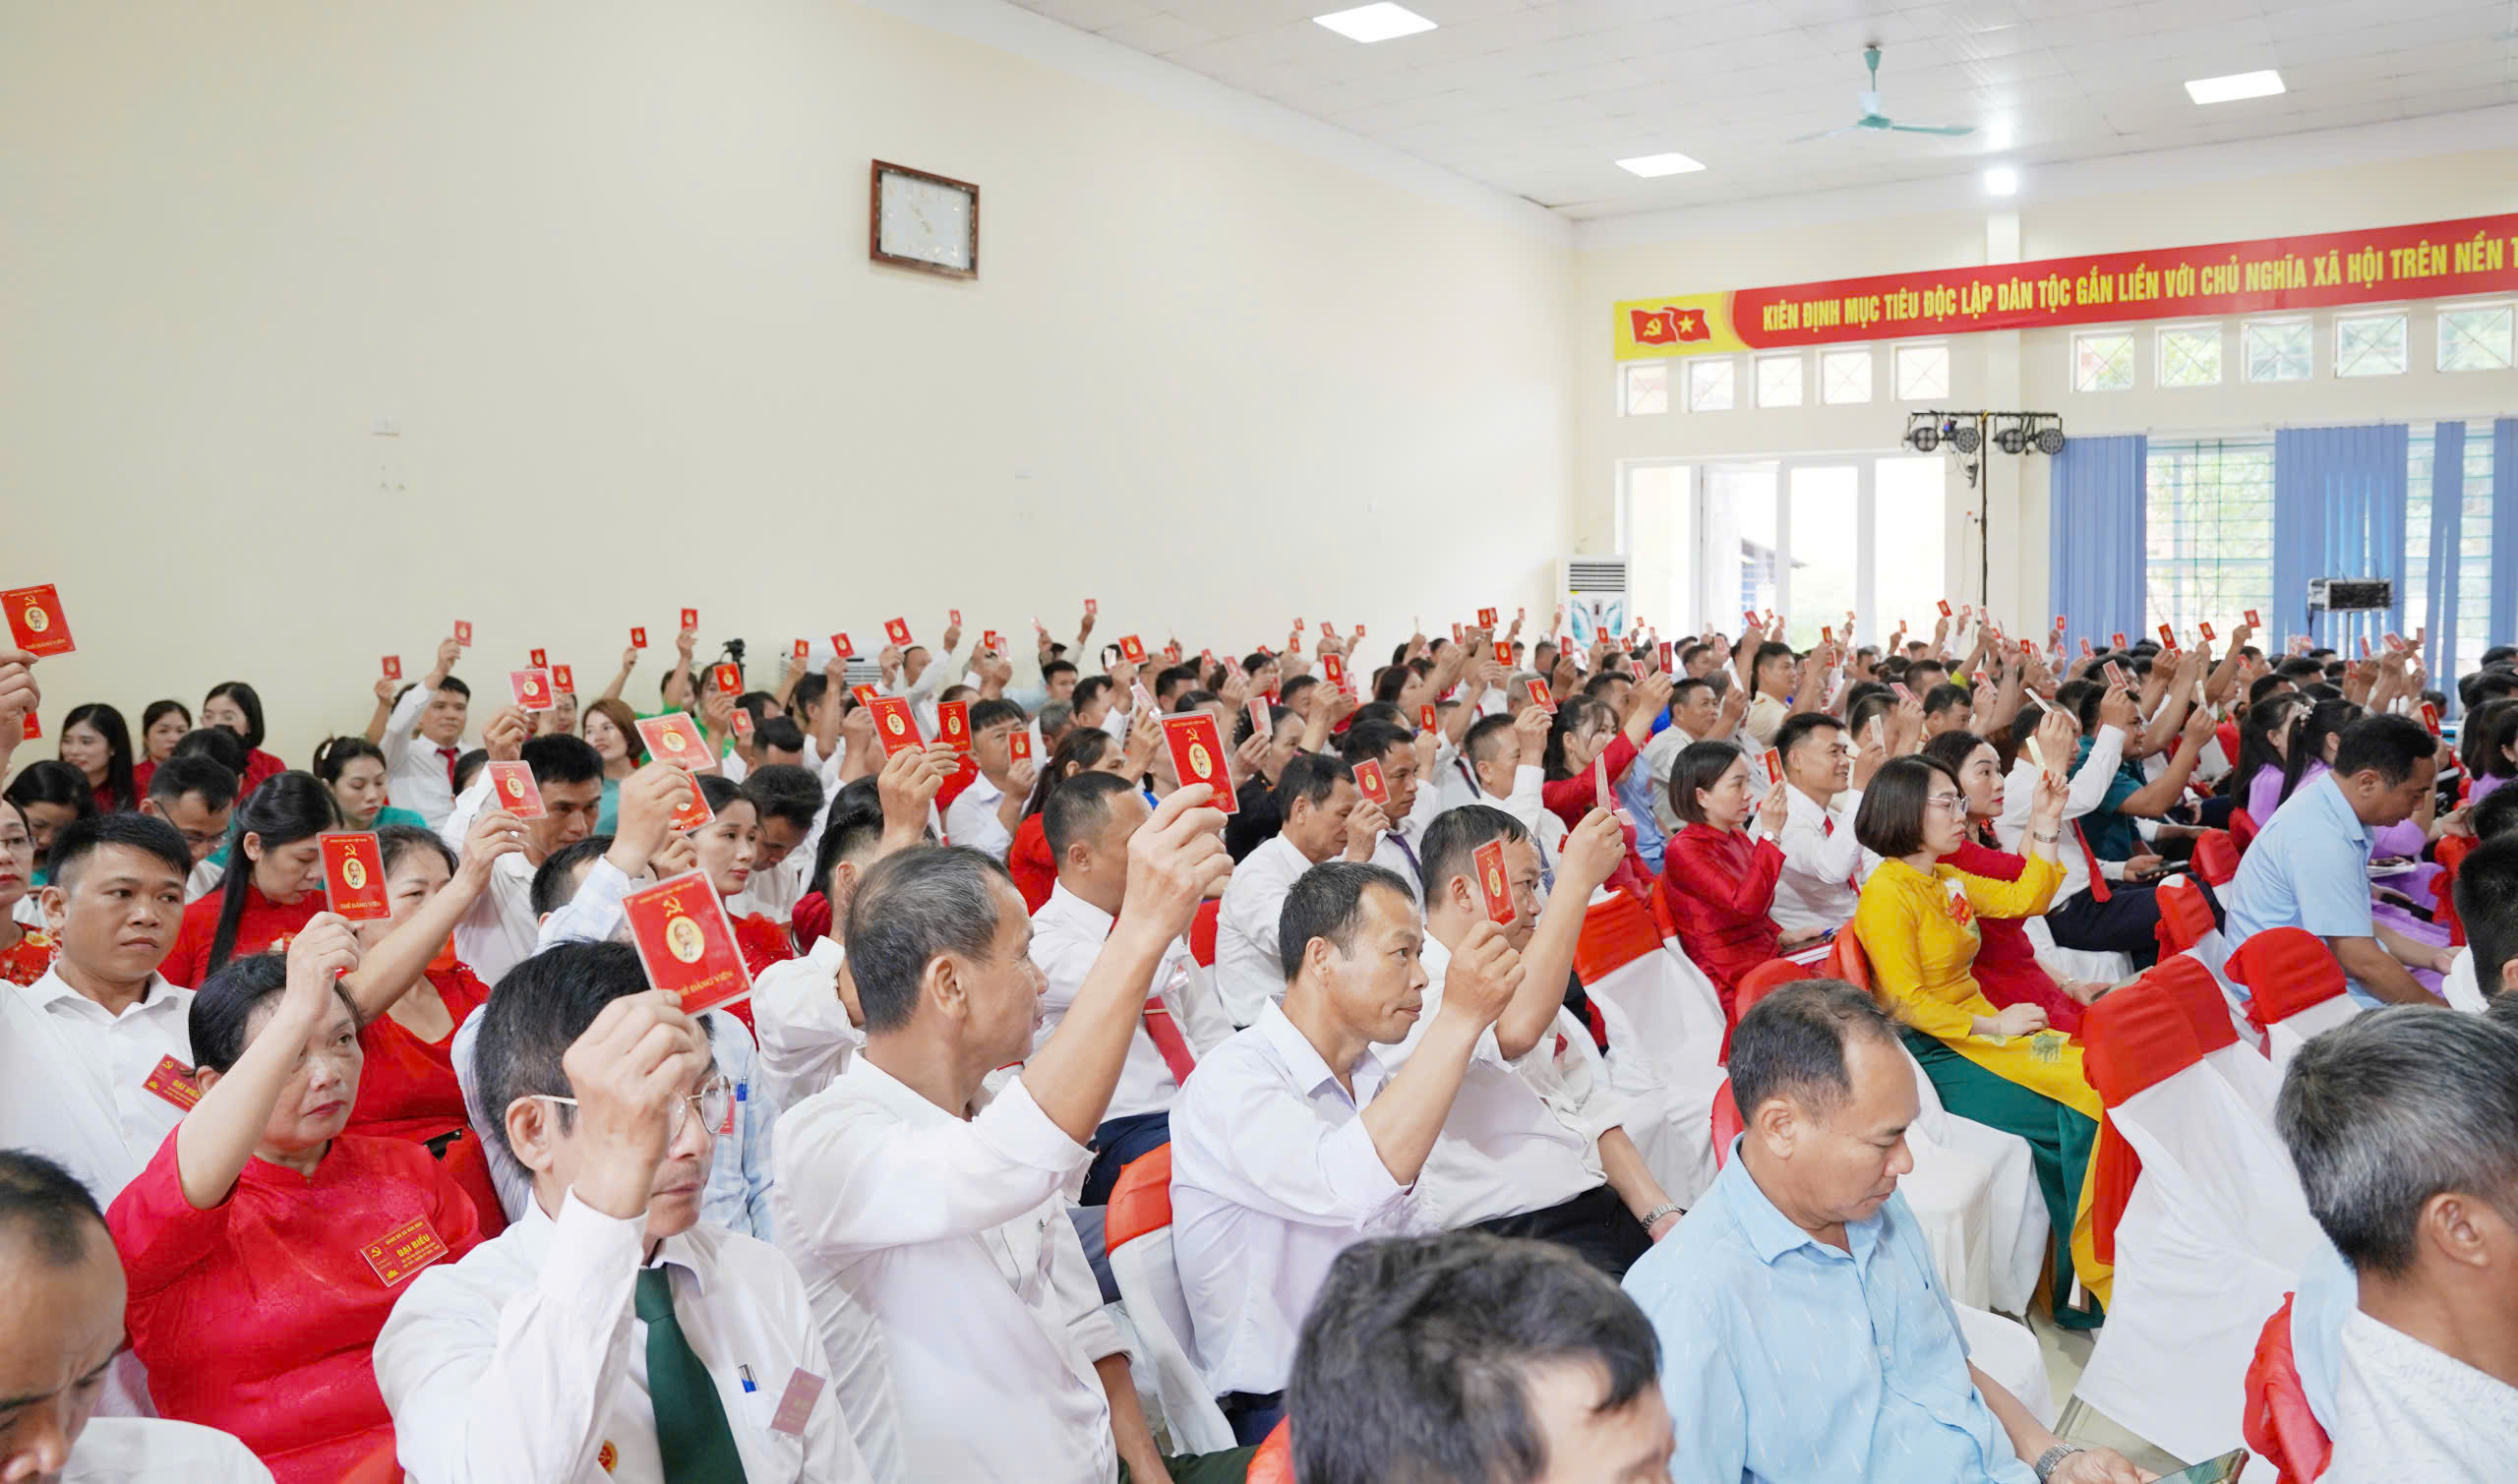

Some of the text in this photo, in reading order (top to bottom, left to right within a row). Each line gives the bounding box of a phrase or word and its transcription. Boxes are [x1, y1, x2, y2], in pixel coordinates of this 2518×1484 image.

[1763, 299, 1799, 331] KIÊN
[1802, 300, 1840, 333] ĐỊNH
[1844, 295, 1881, 328] MỤC
[1884, 287, 1920, 321] TIÊU
[1923, 283, 1957, 323] ĐỘC
[1960, 279, 1994, 320] LẬP
[1998, 276, 2034, 312] DÂN
[2037, 274, 2071, 314] TỘC
[2075, 266, 2114, 306] GẮN
[2118, 264, 2160, 302] LIỀN
[2164, 262, 2196, 298] VỚI
[2200, 255, 2240, 295] CHỦ
[2245, 254, 2307, 292] NGHĨA
[2312, 250, 2342, 286] XÃ
[2347, 246, 2384, 289] HỘI
[2389, 239, 2448, 280] TRÊN
[2454, 230, 2503, 273] NỀN
[396, 1245, 413, 1257] ĐẠI
[411, 1234, 431, 1249] BIỂU
